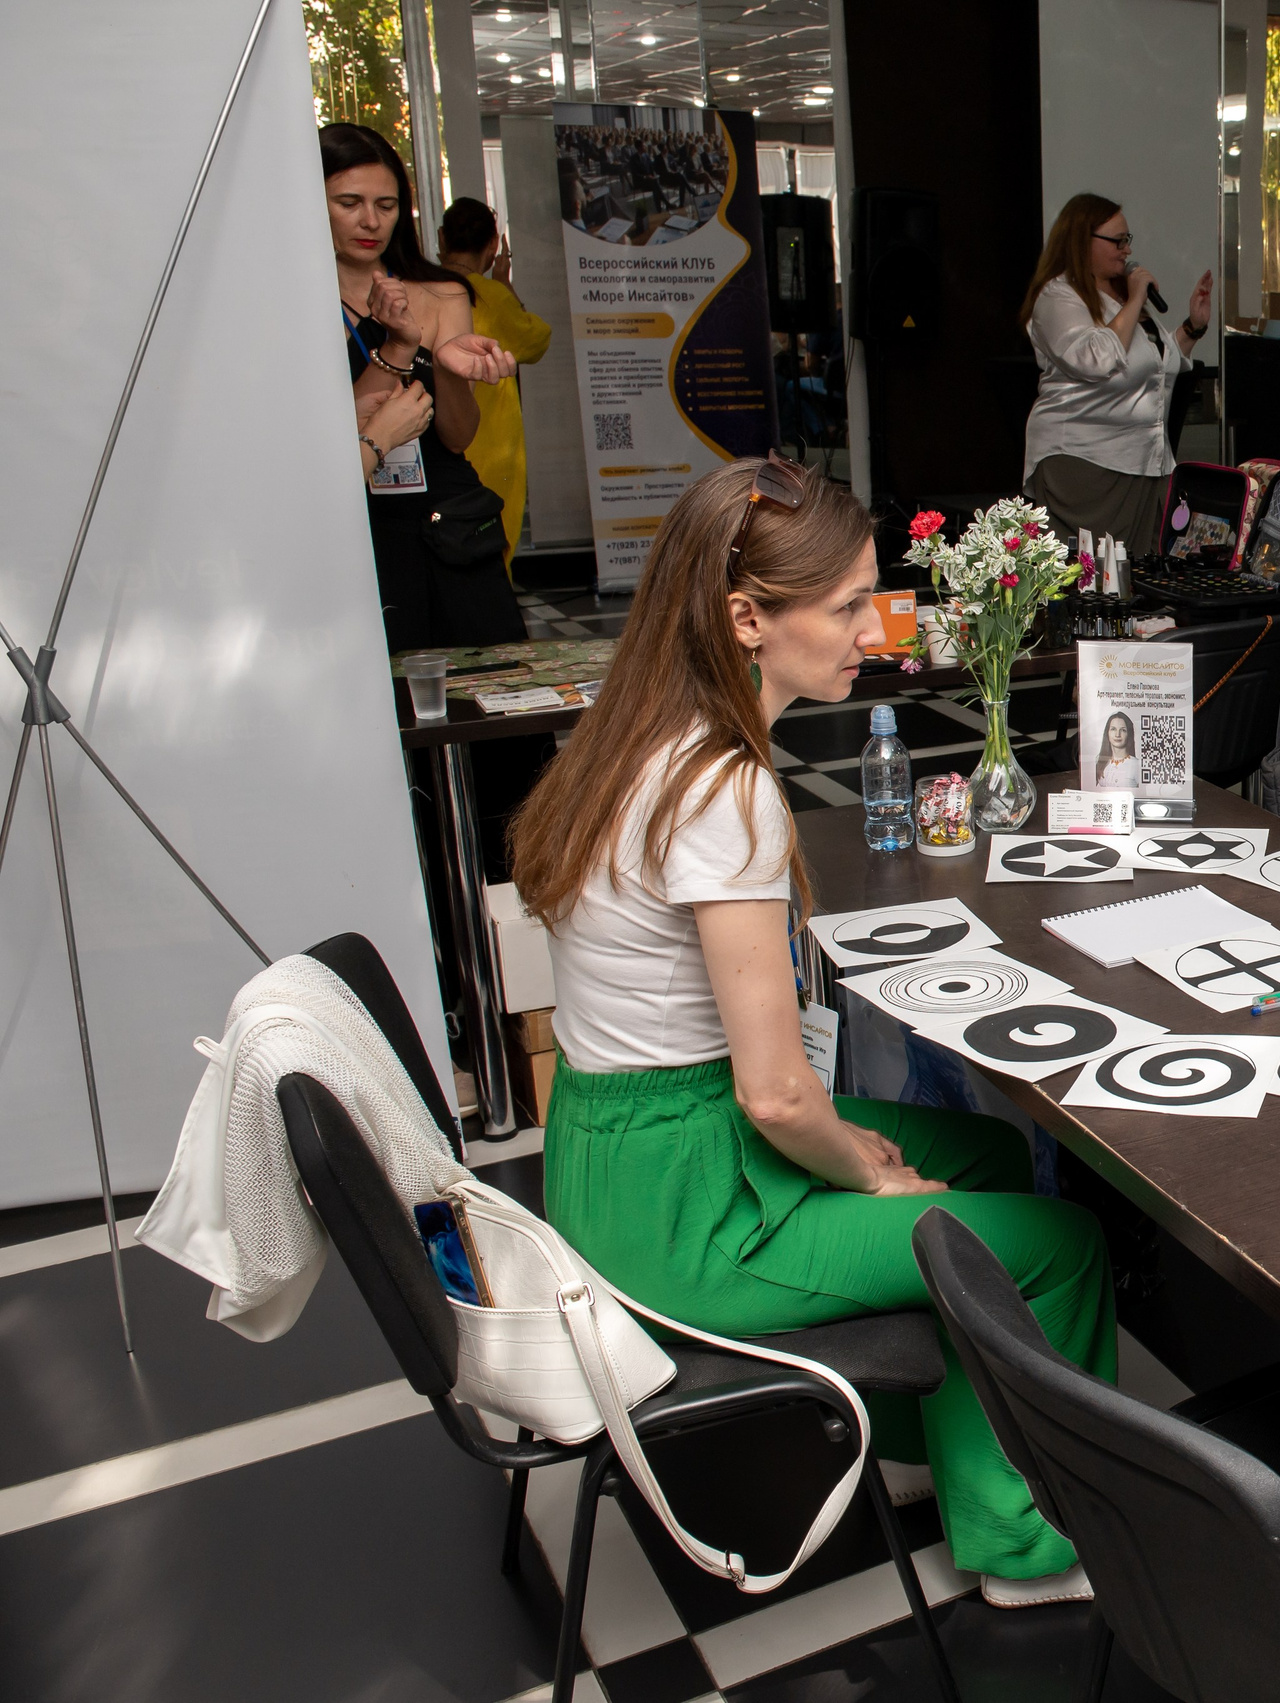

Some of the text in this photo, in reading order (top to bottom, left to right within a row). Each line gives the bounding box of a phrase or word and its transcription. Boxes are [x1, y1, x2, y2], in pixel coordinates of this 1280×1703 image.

[579, 257, 716, 272] Всероссийский КЛУБ
[580, 275, 638, 284] психологии
[648, 276, 715, 285] саморазвития
[582, 288, 695, 304] «Море Инсайтов»
[586, 317, 656, 326] Сильное окружение
[606, 541, 638, 551] +7(928)
[609, 556, 640, 566] +7(987)
[1142, 661, 1184, 670] ИНСАЙТОВ
[1127, 682, 1139, 690] Елена
[804, 1022, 832, 1039] ИНСАЙТОВ
